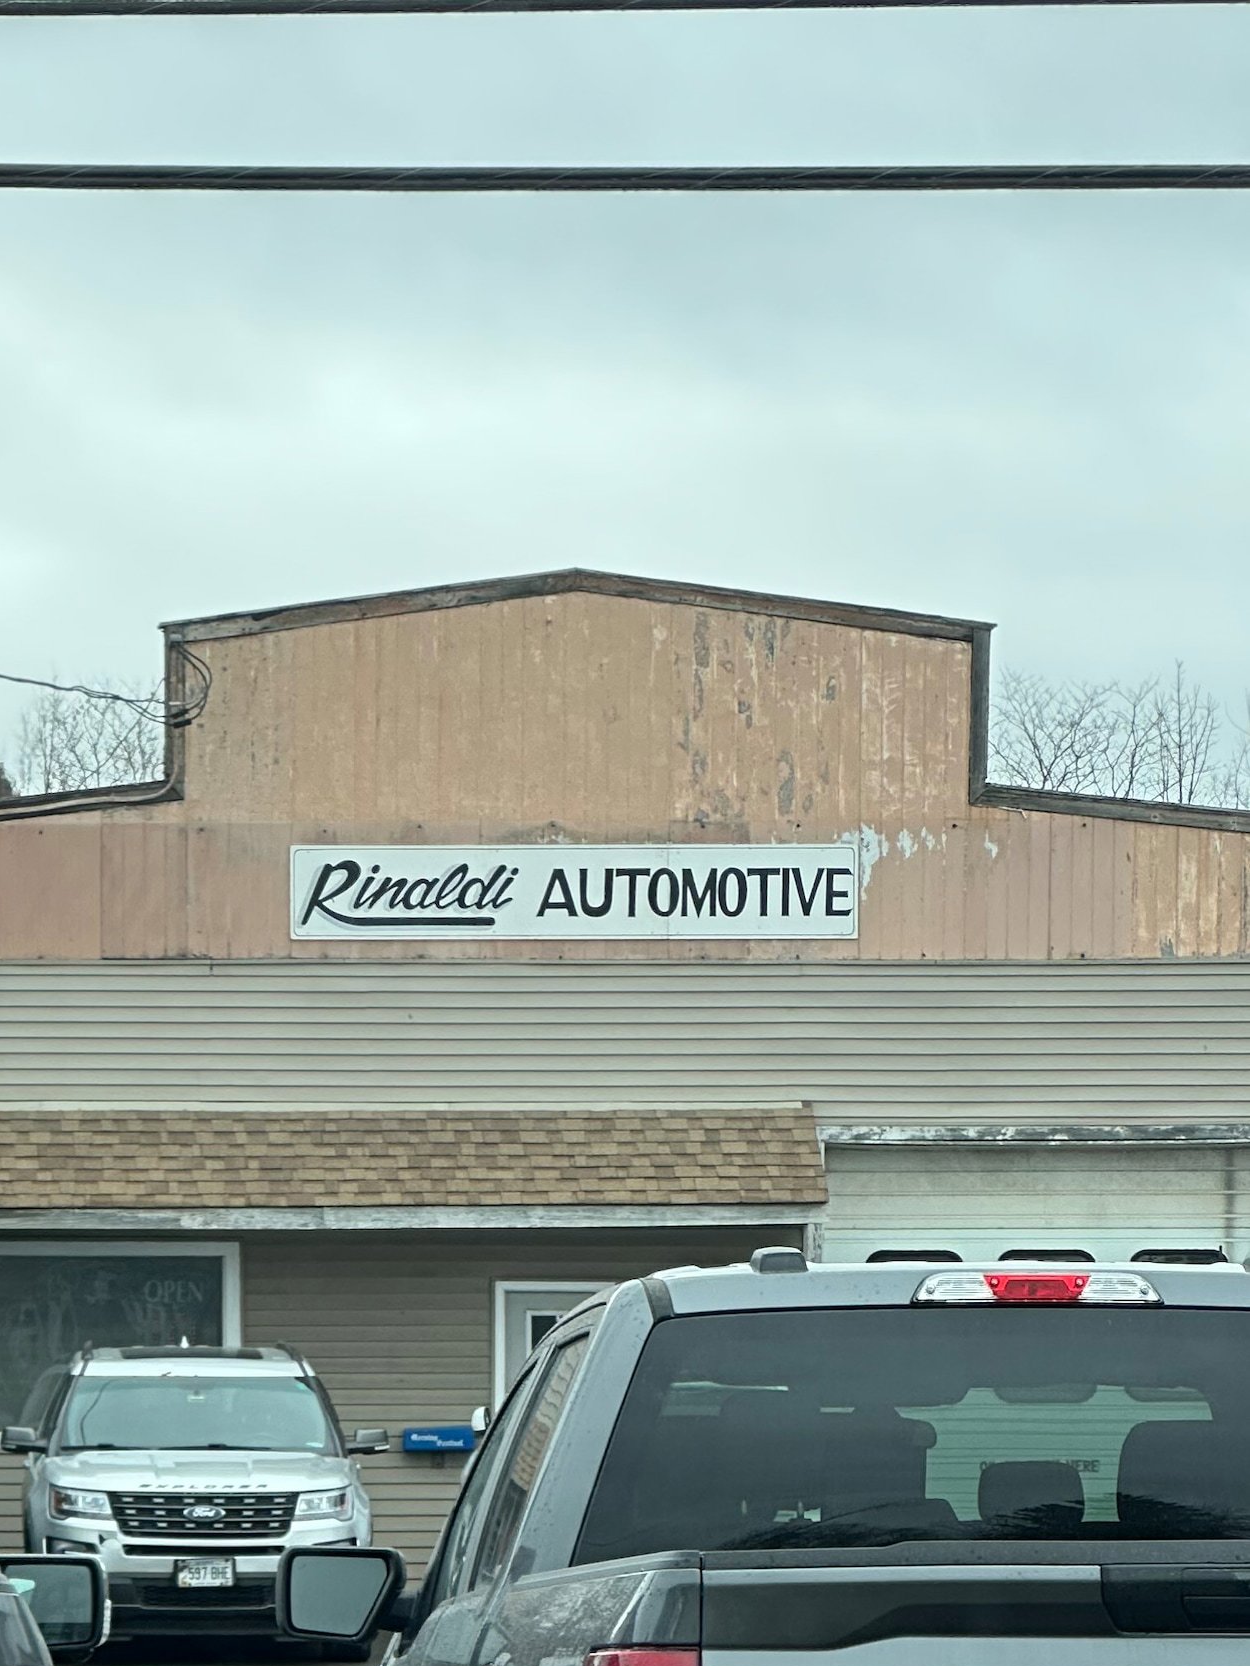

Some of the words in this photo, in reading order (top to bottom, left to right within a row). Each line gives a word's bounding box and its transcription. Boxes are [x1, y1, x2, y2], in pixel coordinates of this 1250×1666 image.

[301, 860, 519, 927] Rinaldi
[537, 867, 854, 918] AUTOMOTIVE
[143, 1279, 203, 1304] OPEN
[138, 1483, 269, 1491] EXPLORER
[192, 1507, 217, 1518] Ford
